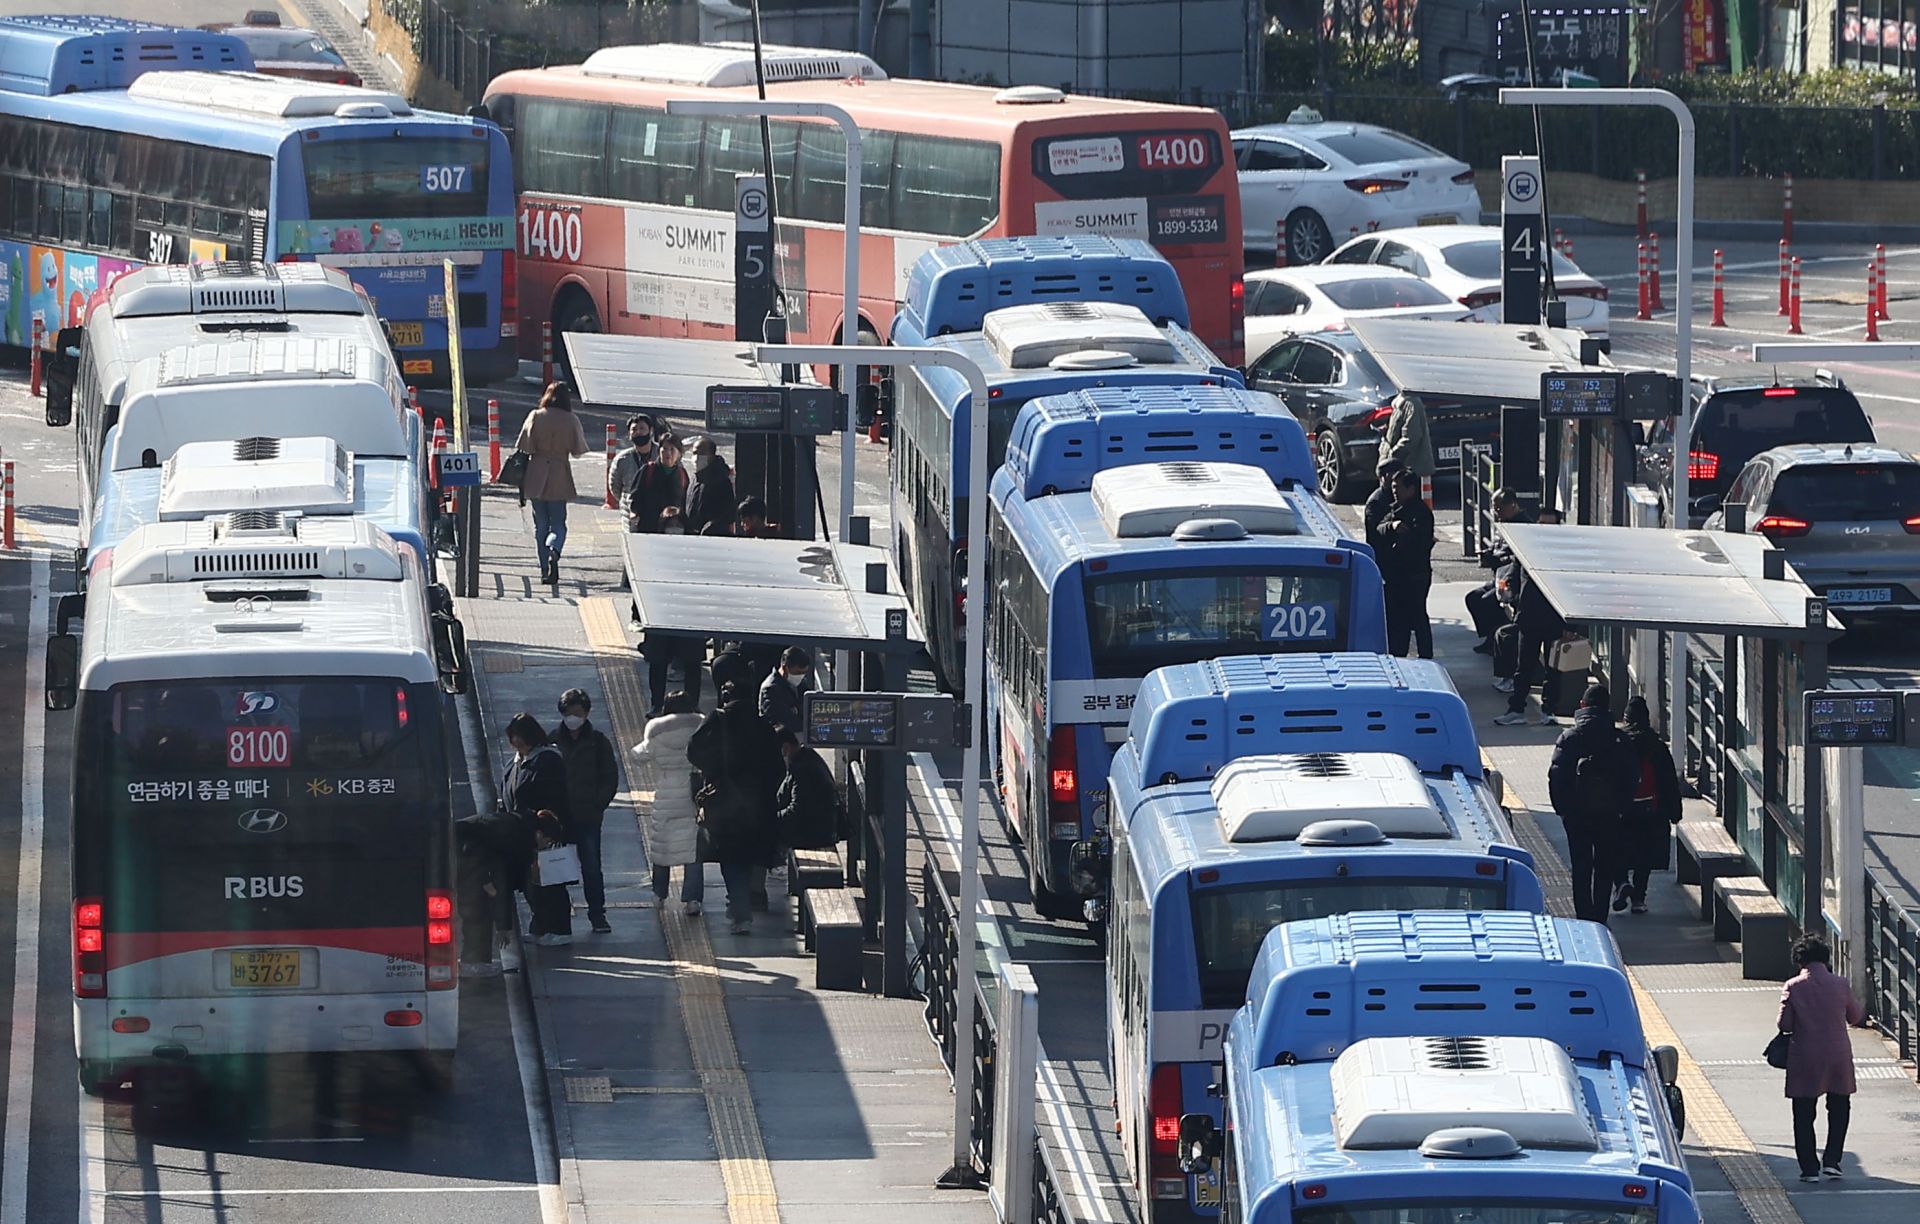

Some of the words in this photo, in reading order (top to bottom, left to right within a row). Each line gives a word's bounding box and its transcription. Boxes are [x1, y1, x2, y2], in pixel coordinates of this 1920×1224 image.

[1538, 18, 1581, 42] 구두
[1141, 138, 1204, 166] 1400
[426, 166, 466, 191] 507
[458, 222, 504, 239] HECHI
[1075, 212, 1138, 228] SUMMIT
[1158, 219, 1218, 235] 1899-5334
[149, 230, 173, 264] 507
[519, 208, 582, 262] 1400
[665, 225, 727, 253] SUMMIT
[1511, 227, 1535, 260] 4
[743, 245, 765, 278] 5
[1549, 380, 1566, 391] 505
[1583, 380, 1600, 391] 752
[444, 458, 472, 471] 401
[1857, 589, 1887, 602] 2175
[1270, 605, 1328, 638] 202
[814, 702, 841, 714] 8100
[1082, 694, 1112, 710] 공부
[1814, 701, 1834, 714] 505
[1855, 700, 1876, 713] 752
[229, 730, 288, 764] 8100
[127, 780, 193, 802] 연금하기
[196, 780, 231, 801] 좋을
[234, 778, 270, 799] 때다
[338, 779, 365, 795] KB
[366, 778, 396, 795] 증권
